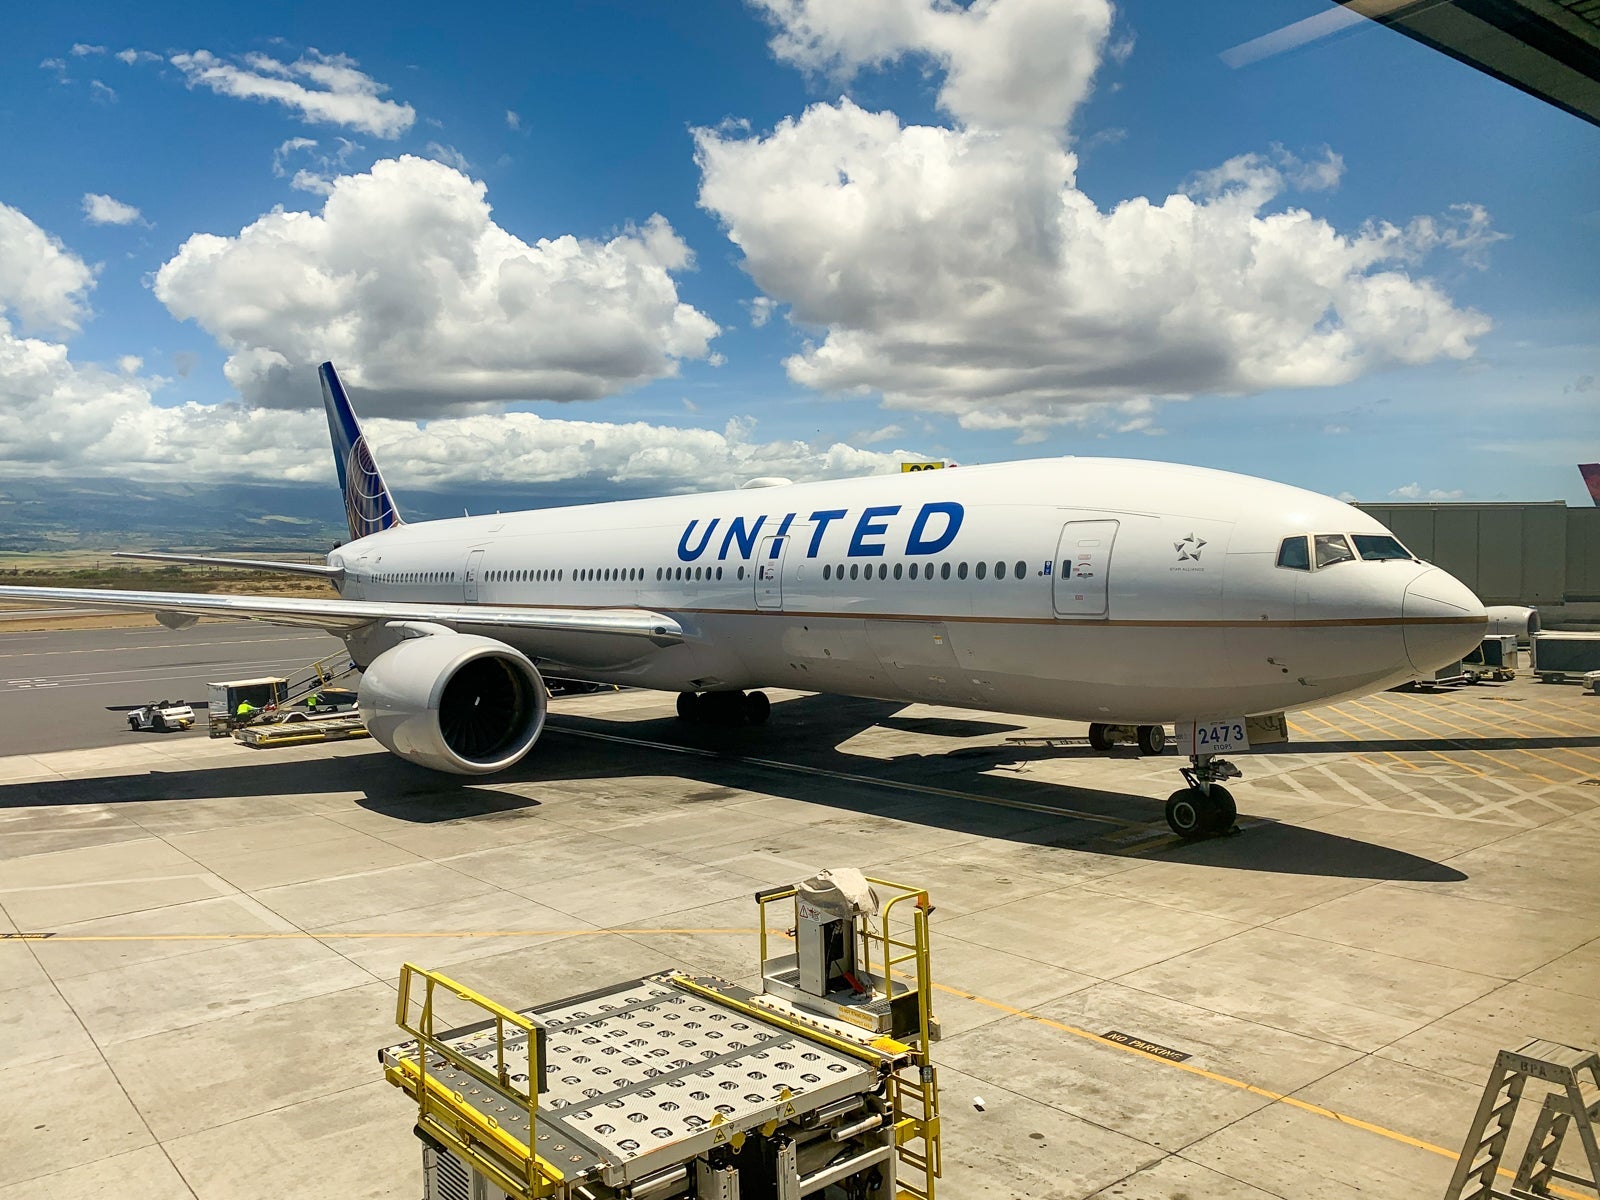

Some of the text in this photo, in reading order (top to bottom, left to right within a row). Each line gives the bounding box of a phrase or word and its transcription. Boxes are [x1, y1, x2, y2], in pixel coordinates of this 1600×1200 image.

[677, 501, 965, 562] UNITED
[1198, 724, 1244, 745] 2473
[1108, 1033, 1183, 1059] NO PARKING
